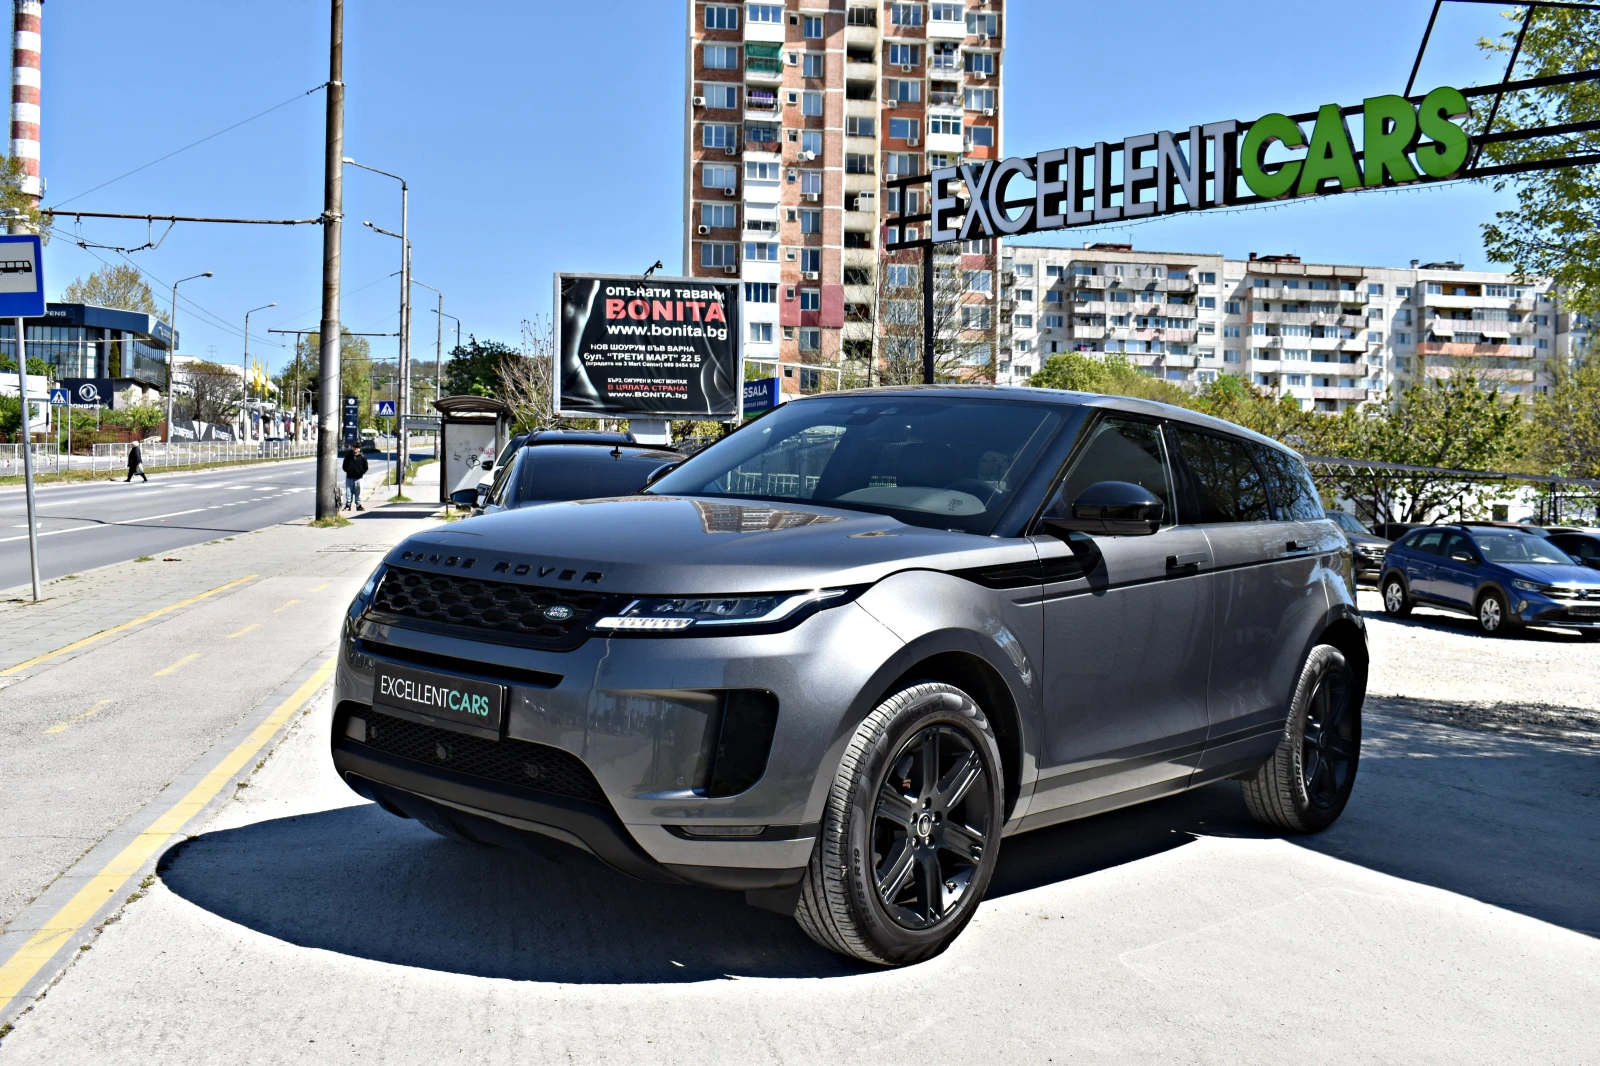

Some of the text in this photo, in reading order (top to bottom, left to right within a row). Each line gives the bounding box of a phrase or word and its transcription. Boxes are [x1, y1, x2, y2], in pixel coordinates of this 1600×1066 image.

[606, 286, 725, 300] опънати тавани
[606, 298, 726, 322] BONITA
[607, 324, 728, 340] www.bonita.bg
[583, 352, 605, 361] бул.
[493, 561, 605, 585] ROVER
[380, 674, 489, 717] EXCELLENTCARS
